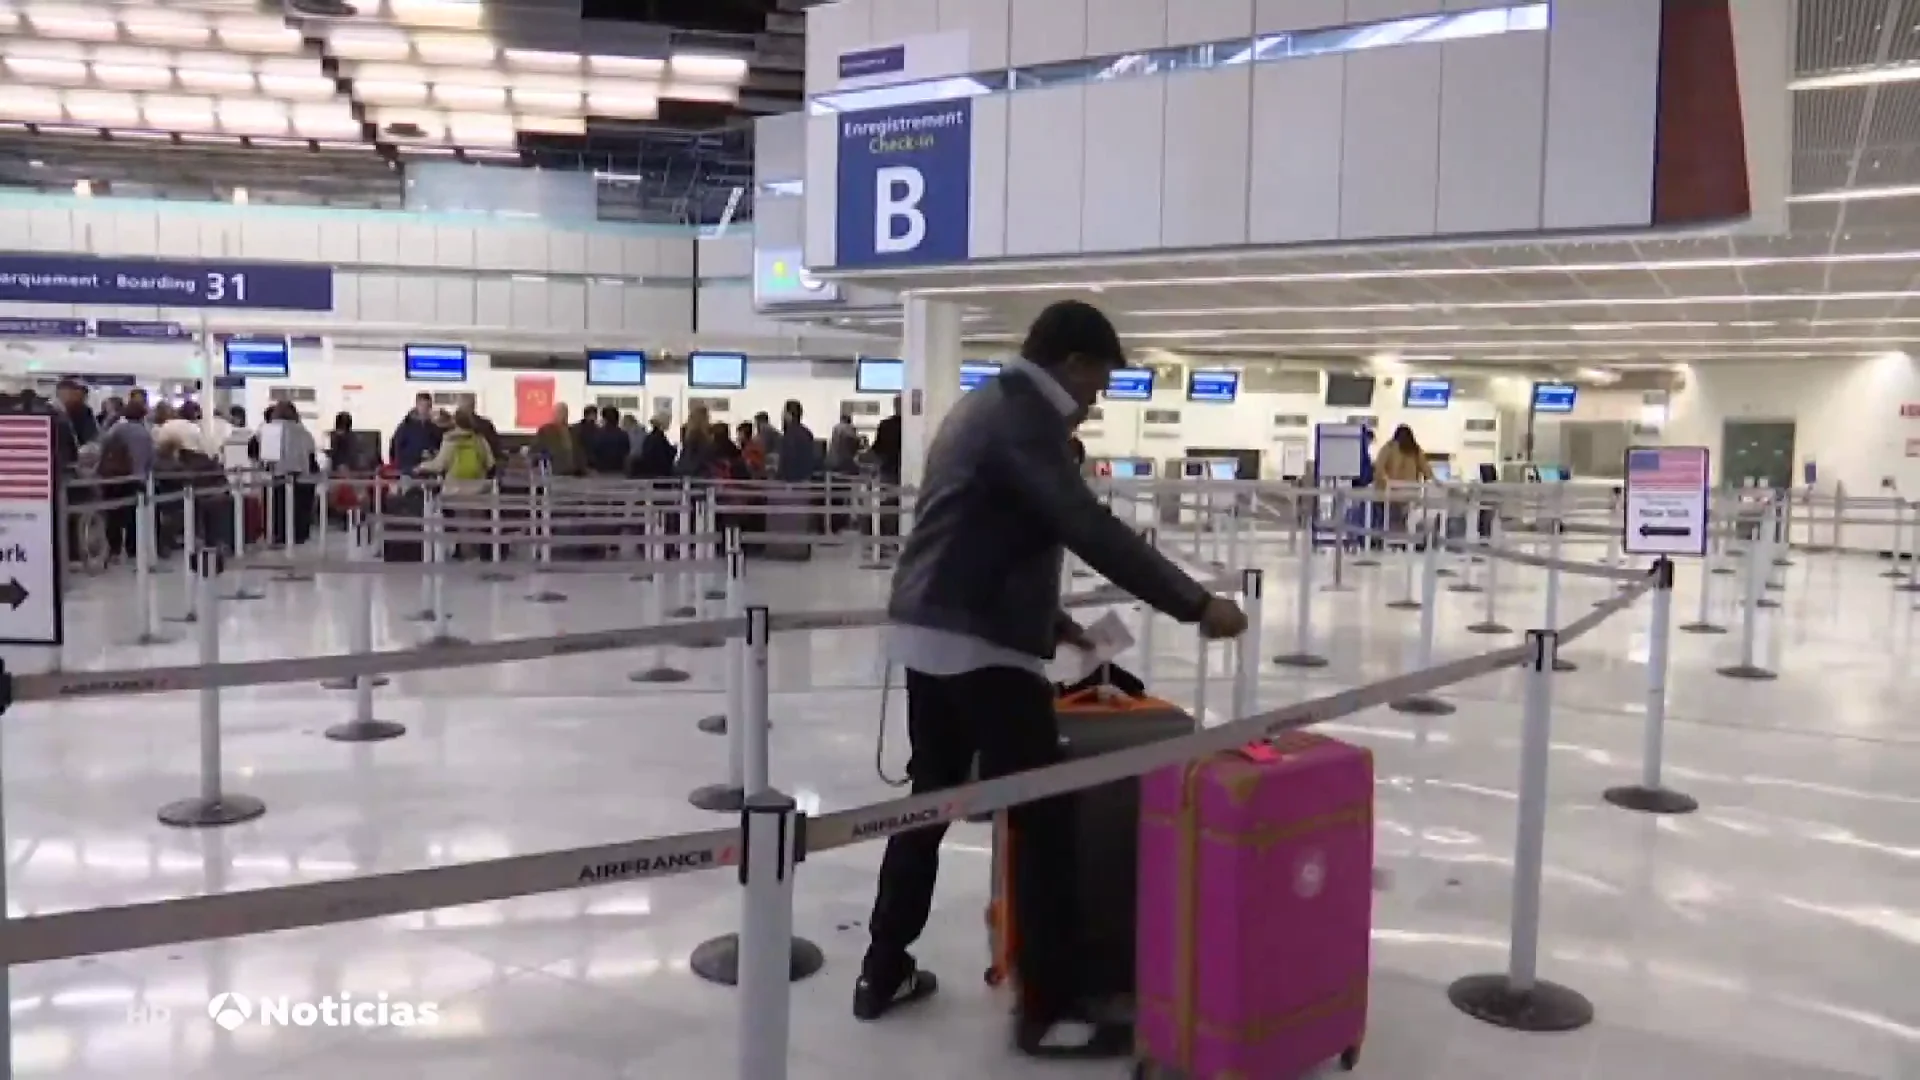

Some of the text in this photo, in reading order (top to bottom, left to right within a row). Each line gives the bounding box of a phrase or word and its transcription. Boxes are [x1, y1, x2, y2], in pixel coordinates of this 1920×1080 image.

[844, 111, 963, 137] Enregistrement
[869, 134, 934, 154] Check-in
[874, 166, 926, 254] B
[116, 274, 196, 292] Boarding
[205, 273, 246, 300] 31
[0, 543, 27, 562] rk
[578, 849, 713, 882] AIRFRANCE
